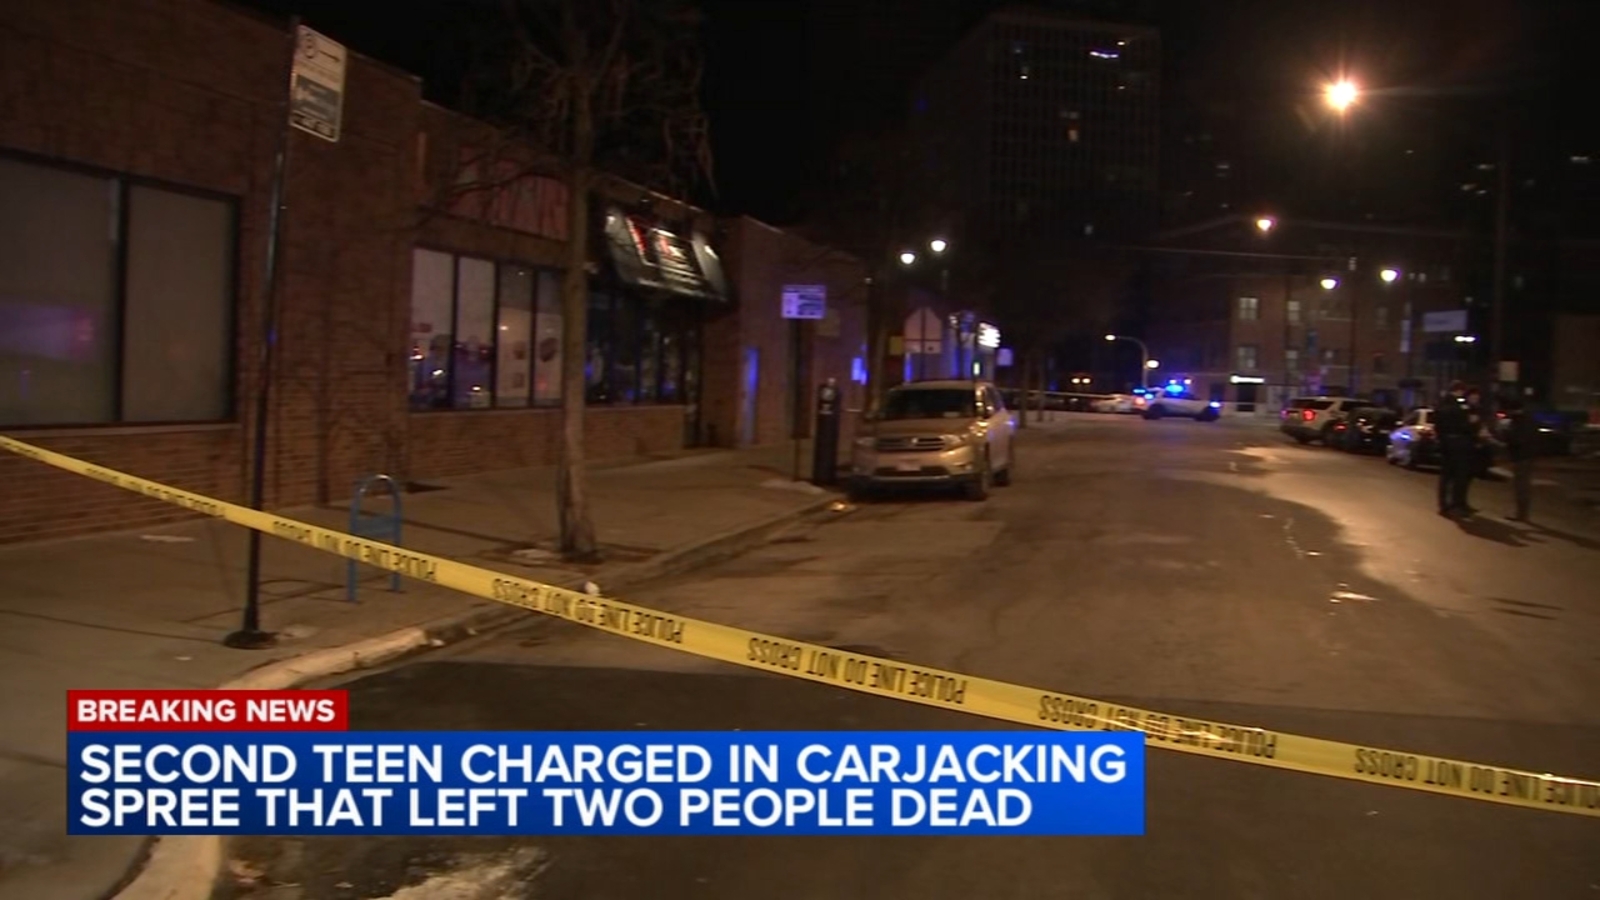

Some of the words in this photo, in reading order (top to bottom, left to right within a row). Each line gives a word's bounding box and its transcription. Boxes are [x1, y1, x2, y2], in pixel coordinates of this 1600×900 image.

[492, 577, 539, 608] CROSS
[544, 590, 571, 614] NOT
[574, 598, 597, 623] DO
[599, 603, 630, 632] LINE
[632, 611, 684, 643] POLICE
[748, 637, 802, 671] CROSS
[805, 650, 842, 680] NOT
[844, 657, 868, 686] DO
[869, 662, 907, 694] LINE
[908, 669, 967, 704] POLICE
[1038, 694, 1098, 729] CROSS
[1214, 725, 1276, 759] POLICE
[1355, 748, 1418, 781] CROSS
[1424, 758, 1464, 789] NOT
[1470, 765, 1496, 794] DO
[1499, 770, 1541, 801] LINE
[1546, 781, 1600, 810] OLICE
